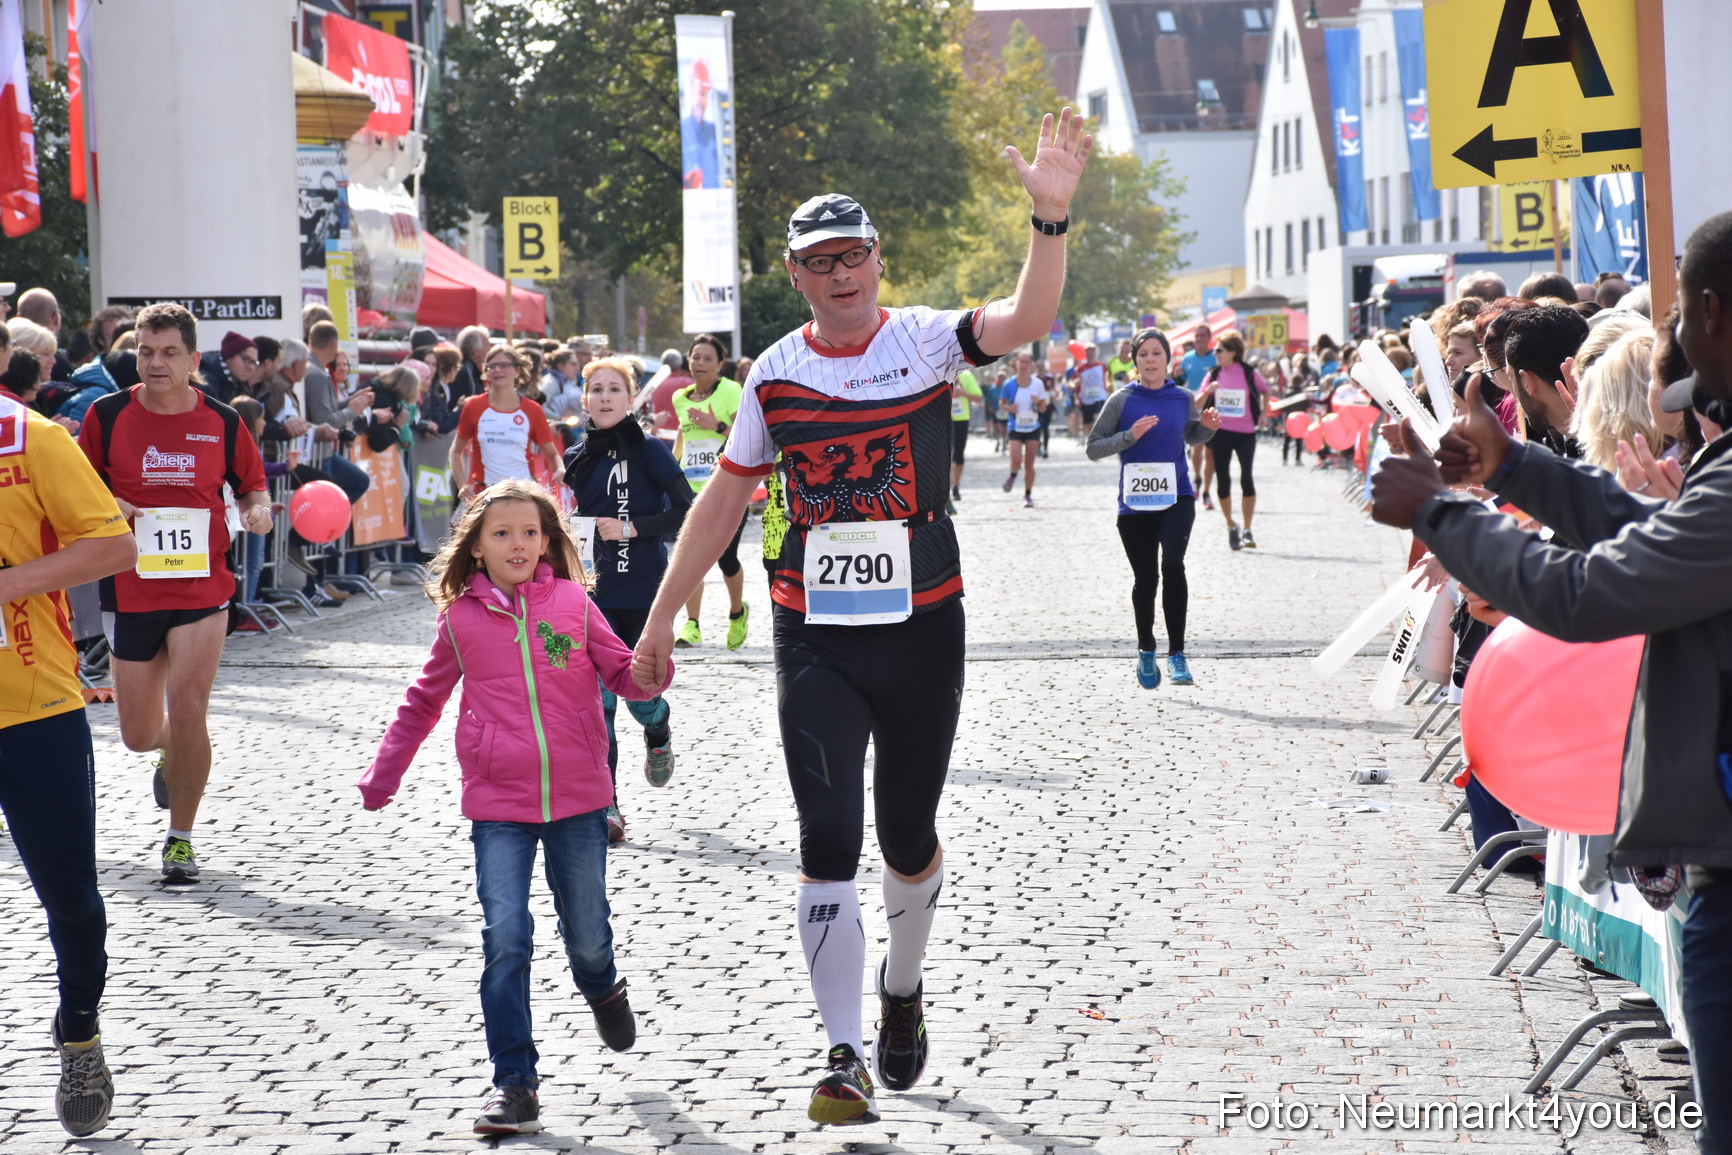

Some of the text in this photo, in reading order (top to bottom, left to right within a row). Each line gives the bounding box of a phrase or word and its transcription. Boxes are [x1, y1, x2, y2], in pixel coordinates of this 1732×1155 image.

[1477, 0, 1615, 108] A
[510, 201, 551, 215] Block
[1515, 192, 1545, 232] B
[519, 222, 545, 260] B
[1273, 323, 1284, 339] D
[844, 369, 899, 390] NEUMARKT
[1220, 396, 1241, 407] 2567
[687, 452, 714, 466] 2196
[1131, 477, 1168, 492] 2904
[163, 513, 188, 521] BOCK
[154, 529, 192, 551] 115
[839, 531, 877, 541] BOCK
[164, 558, 184, 566] Peter
[818, 553, 894, 585] 2790
